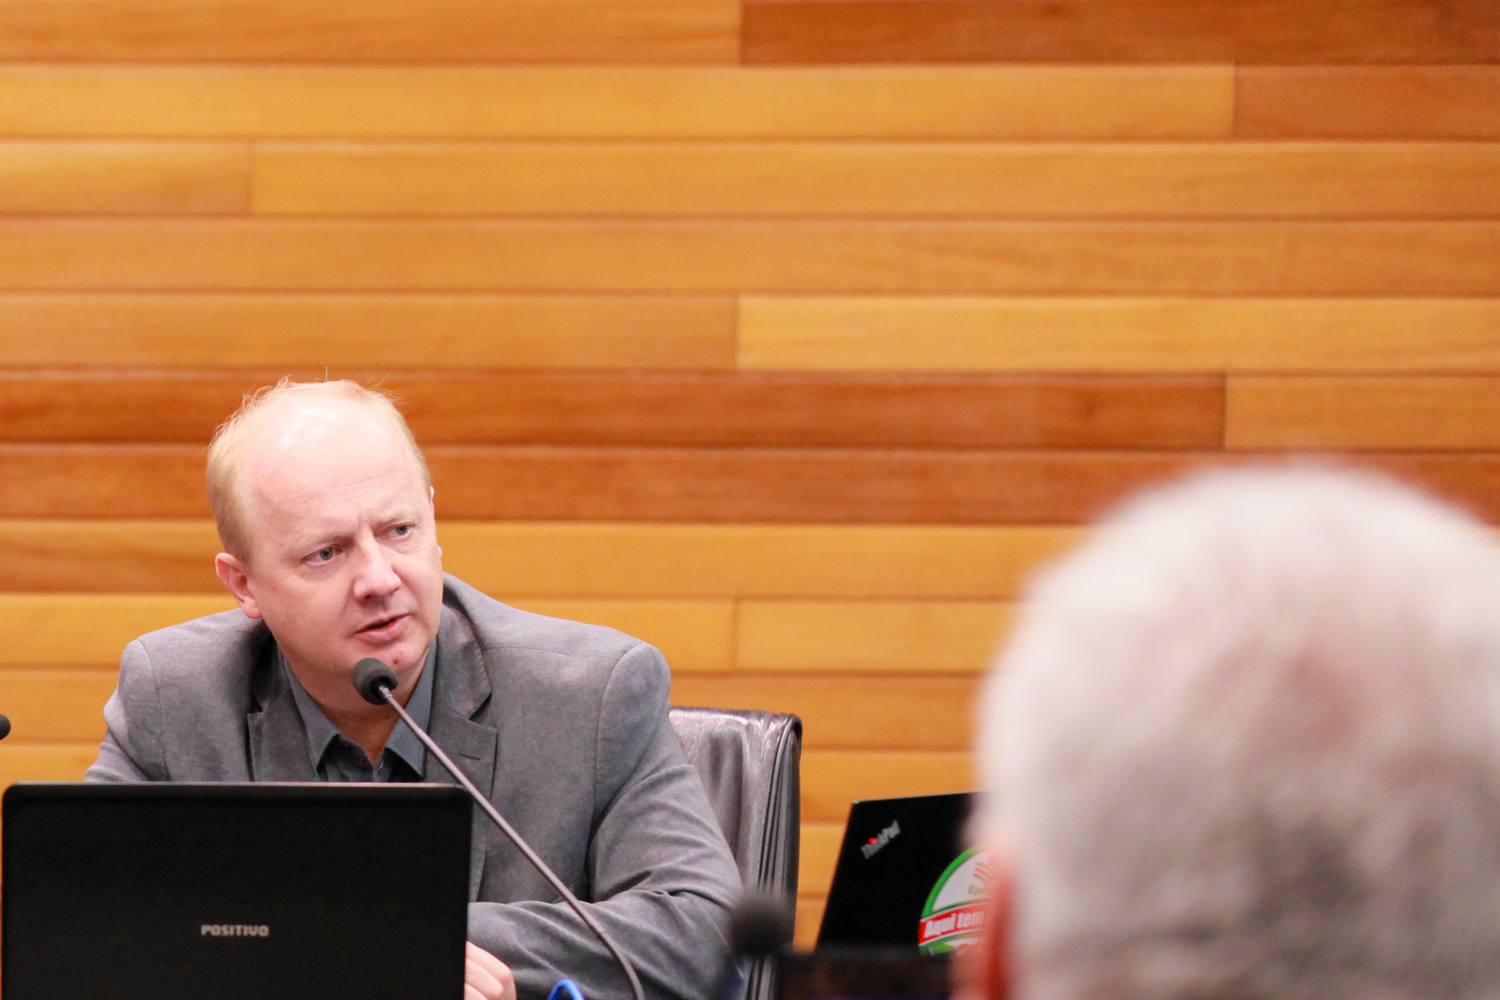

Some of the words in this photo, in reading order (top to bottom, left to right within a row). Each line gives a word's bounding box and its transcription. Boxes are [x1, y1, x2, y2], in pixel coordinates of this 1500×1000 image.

[200, 924, 269, 936] POSITIVO
[924, 913, 957, 938] Aqui
[957, 911, 985, 929] tem
